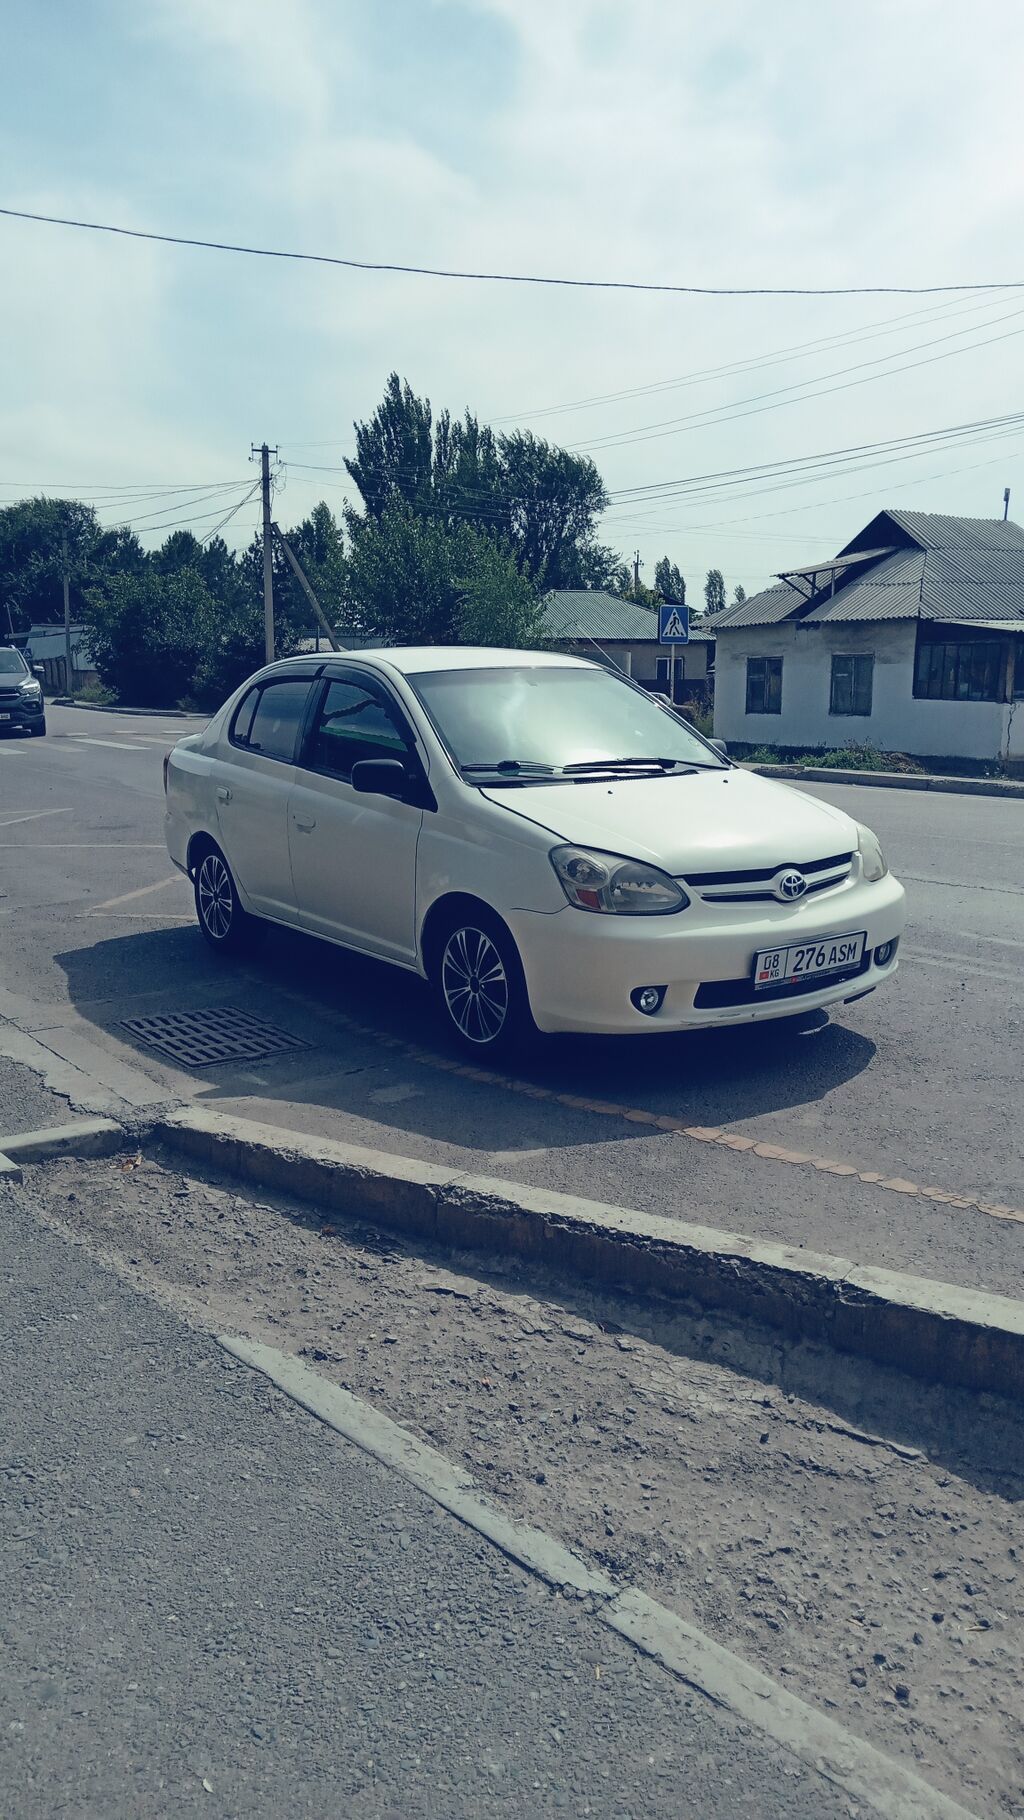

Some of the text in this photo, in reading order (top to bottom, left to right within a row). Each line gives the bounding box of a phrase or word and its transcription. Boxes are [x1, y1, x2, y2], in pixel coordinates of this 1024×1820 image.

[764, 942, 857, 973] 08 276 ASM
[769, 969, 779, 978] KG
